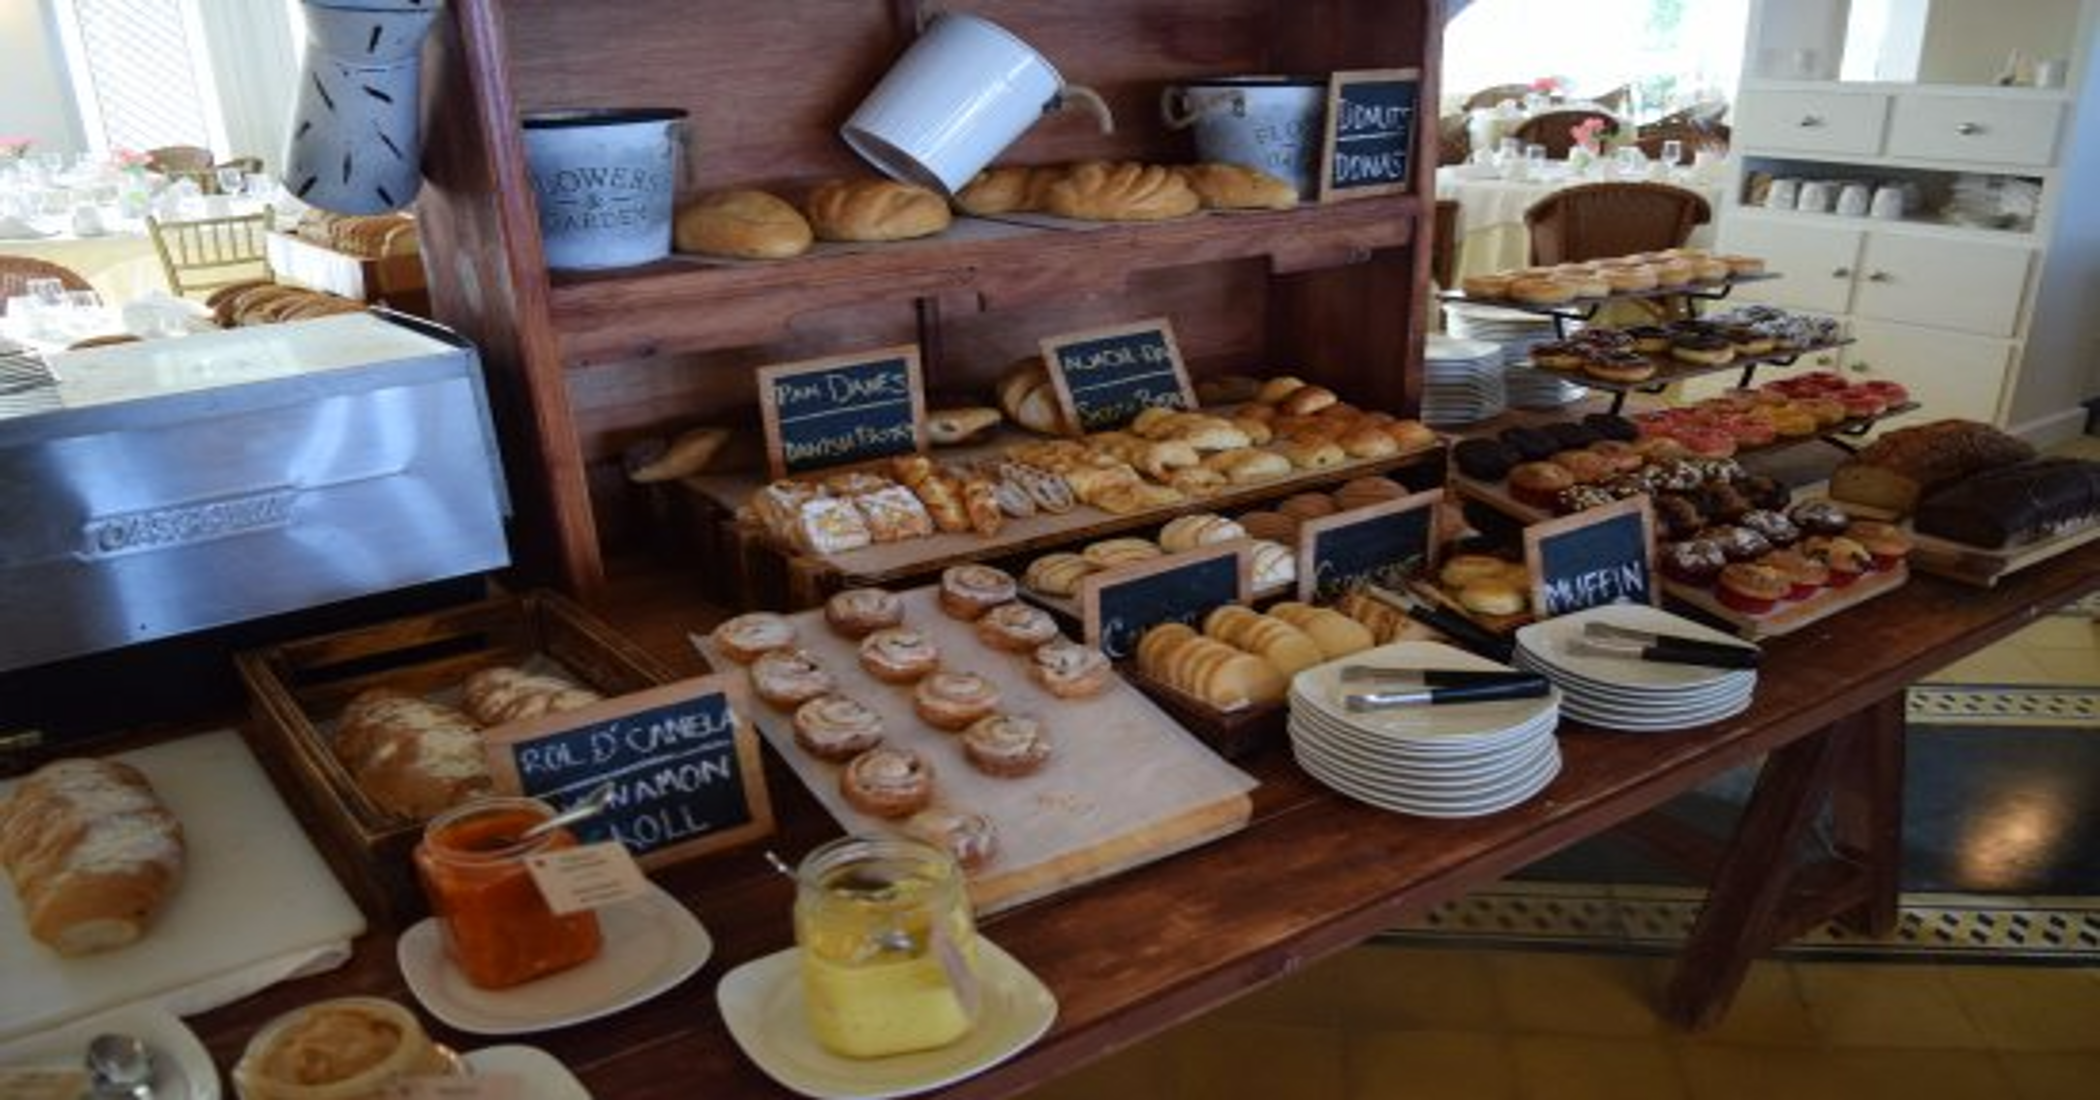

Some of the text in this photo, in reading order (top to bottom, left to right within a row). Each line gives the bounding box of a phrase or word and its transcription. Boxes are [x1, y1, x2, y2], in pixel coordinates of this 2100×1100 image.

[534, 167, 674, 195] LOWERS
[1544, 561, 1643, 613] MUFFIN
[519, 742, 585, 774] ROL
[604, 755, 730, 808] NAMON
